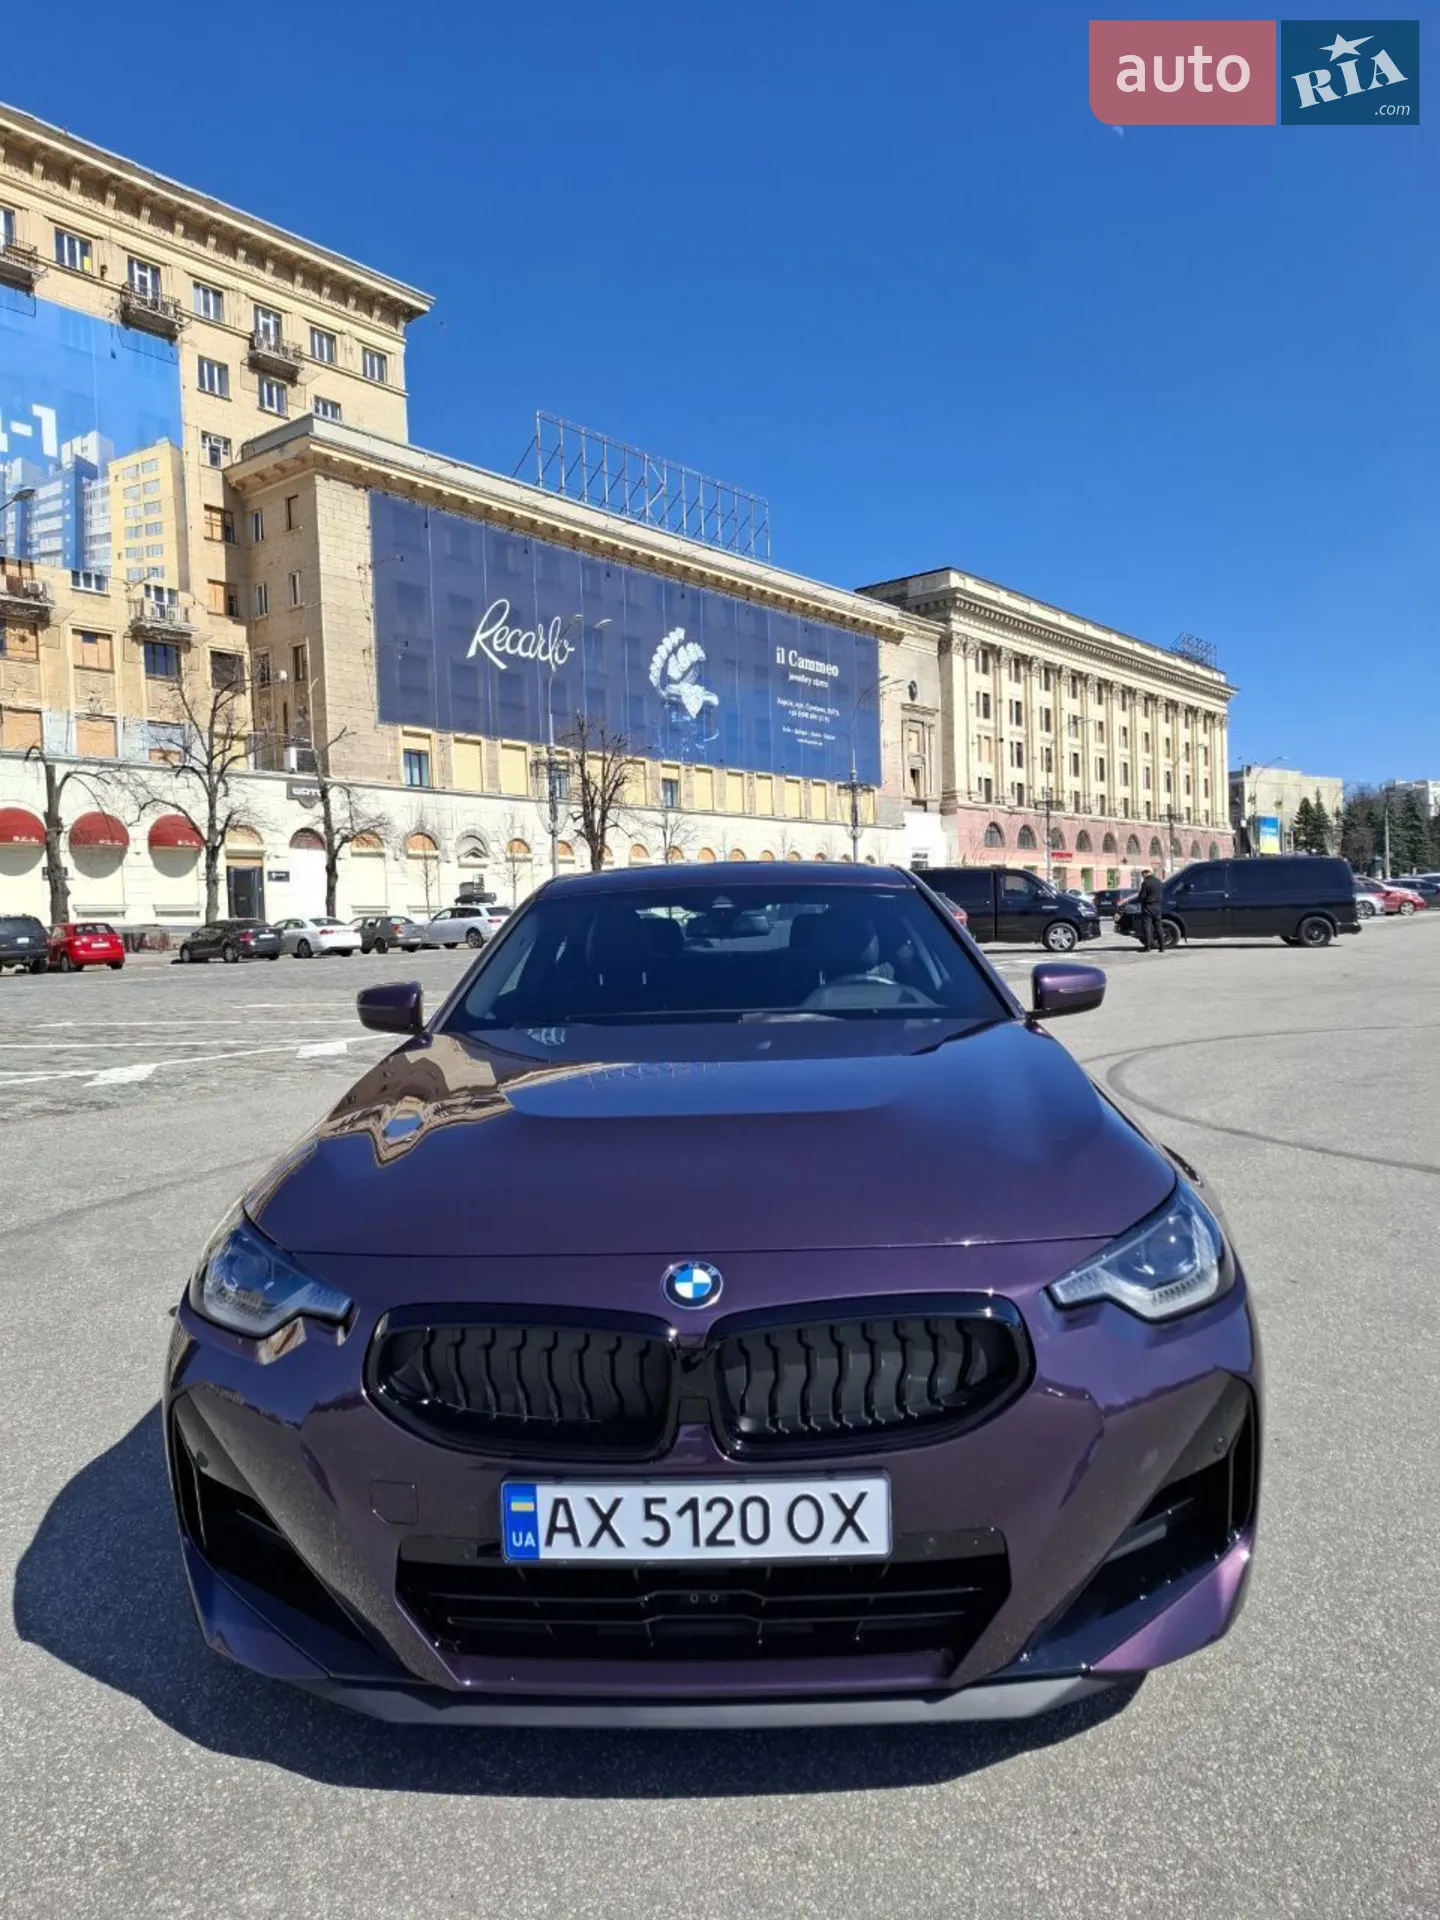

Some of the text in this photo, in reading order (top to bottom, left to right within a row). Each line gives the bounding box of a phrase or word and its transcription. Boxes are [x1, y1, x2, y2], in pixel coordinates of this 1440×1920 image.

[466, 598, 575, 672] Recarlo
[788, 649, 840, 677] Cammeo
[511, 1531, 536, 1548] UA
[544, 1491, 871, 1548] AX 5120 OX
